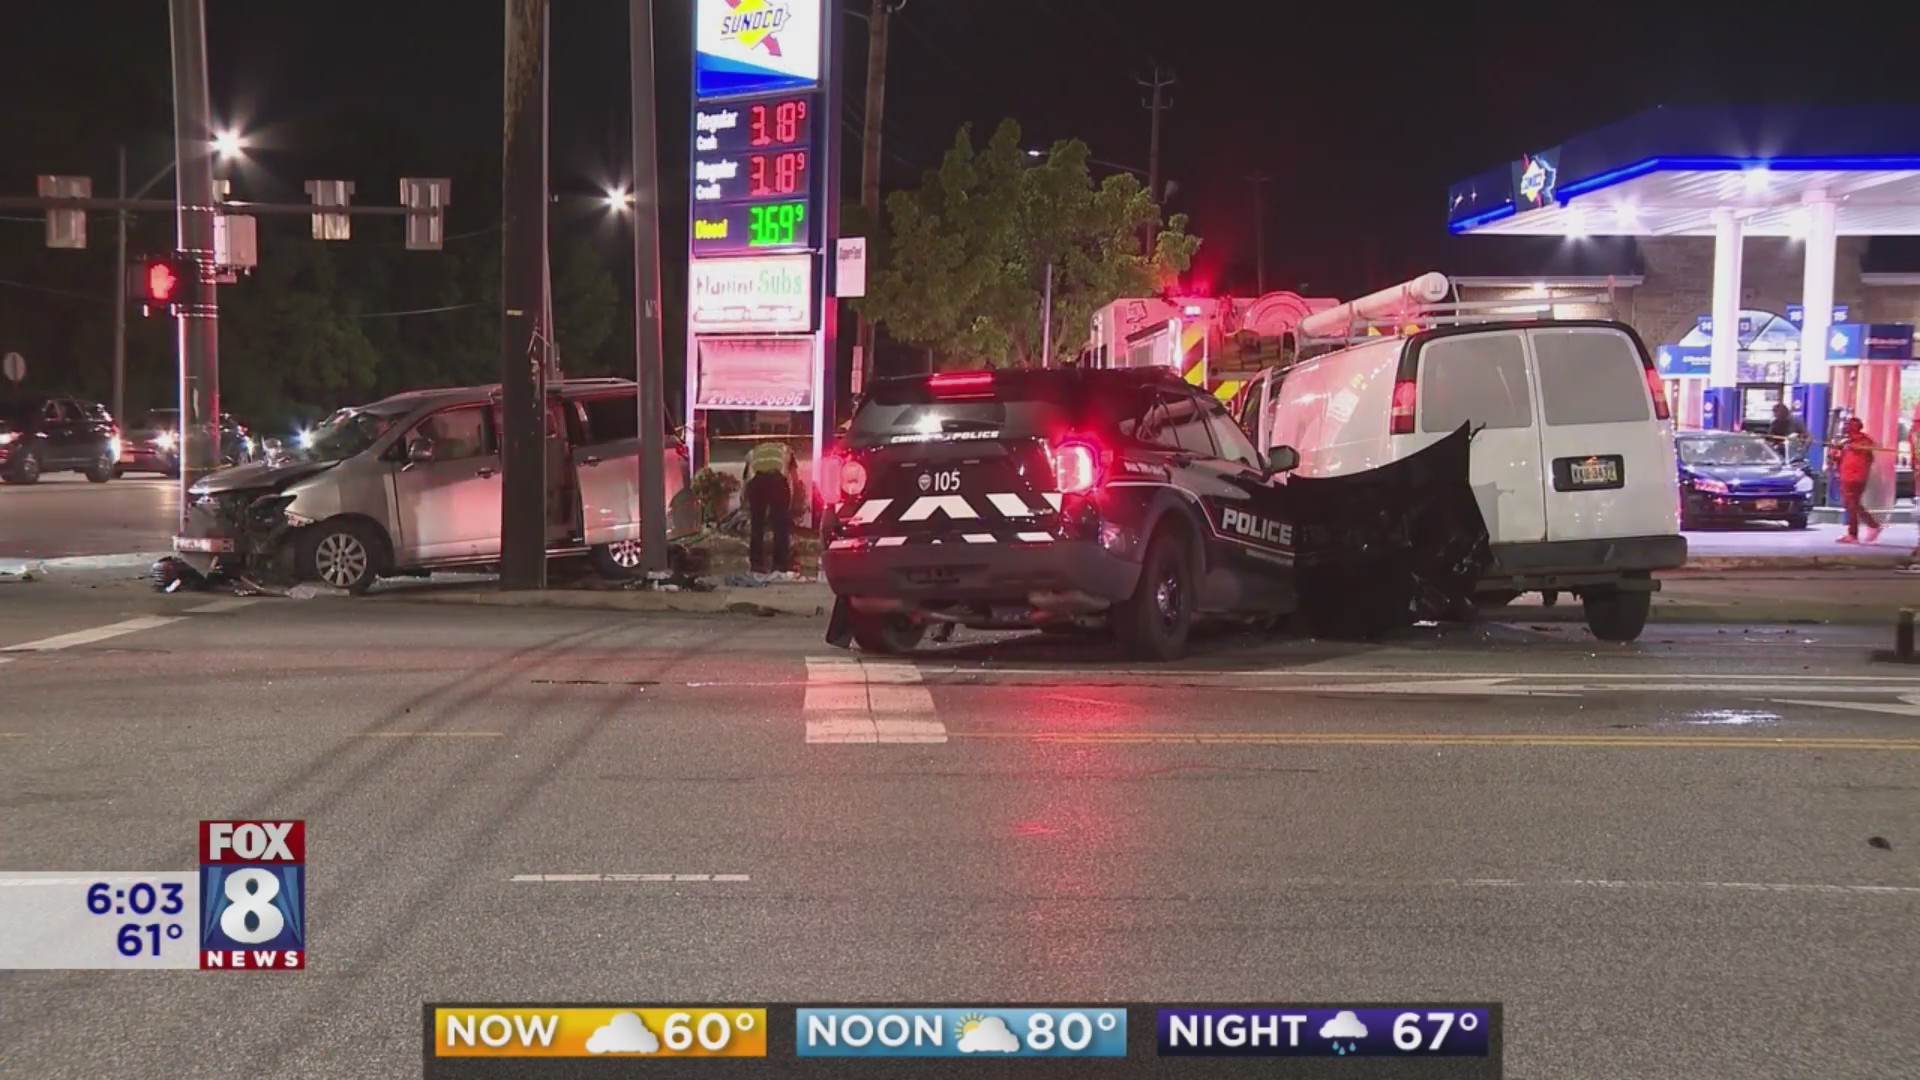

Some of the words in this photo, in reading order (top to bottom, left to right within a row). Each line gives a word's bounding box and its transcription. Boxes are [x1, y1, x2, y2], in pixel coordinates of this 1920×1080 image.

[721, 8, 784, 35] SUNOCO
[695, 218, 728, 239] Diesel
[758, 267, 802, 296] Subs
[952, 430, 999, 441] POLICE
[934, 470, 961, 492] 105
[1221, 507, 1293, 546] POLICE
